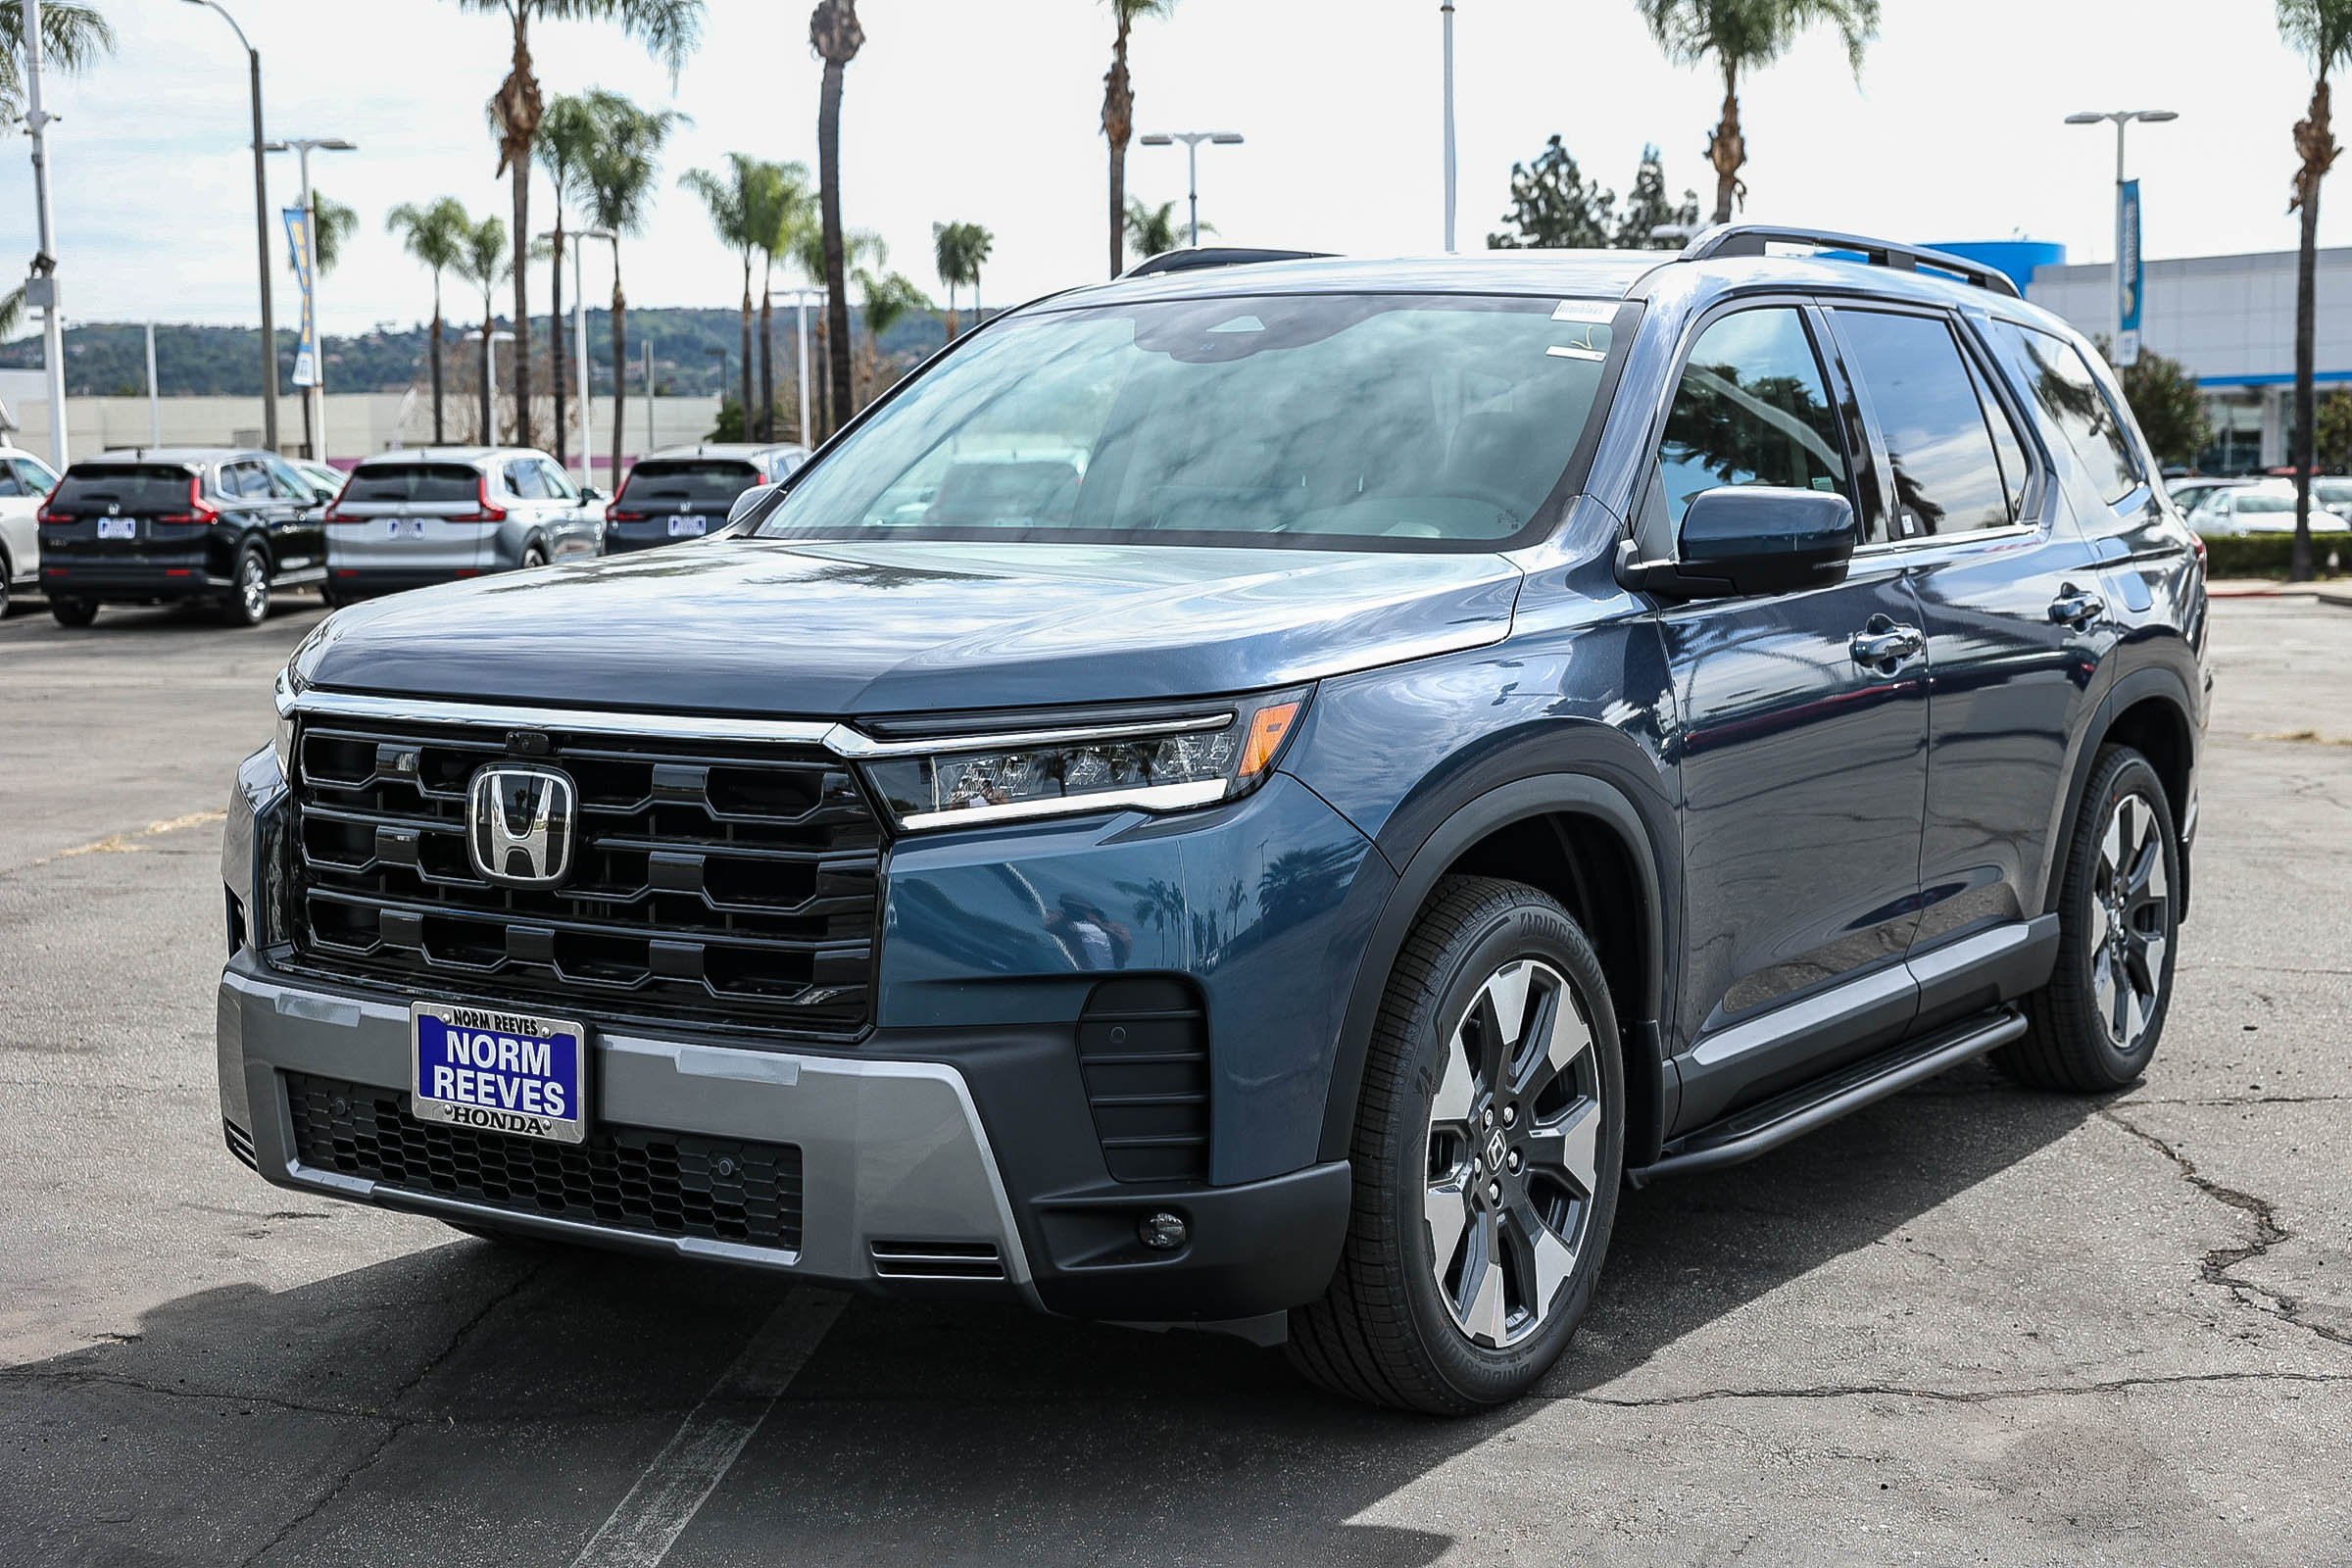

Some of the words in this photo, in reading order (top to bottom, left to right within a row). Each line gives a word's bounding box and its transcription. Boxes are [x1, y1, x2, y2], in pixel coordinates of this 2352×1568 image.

[453, 1009, 491, 1030] NORM
[494, 1015, 539, 1037] REEVES
[446, 1030, 551, 1077] NORM
[433, 1064, 565, 1116] REEVES
[452, 1105, 546, 1137] HONDA
